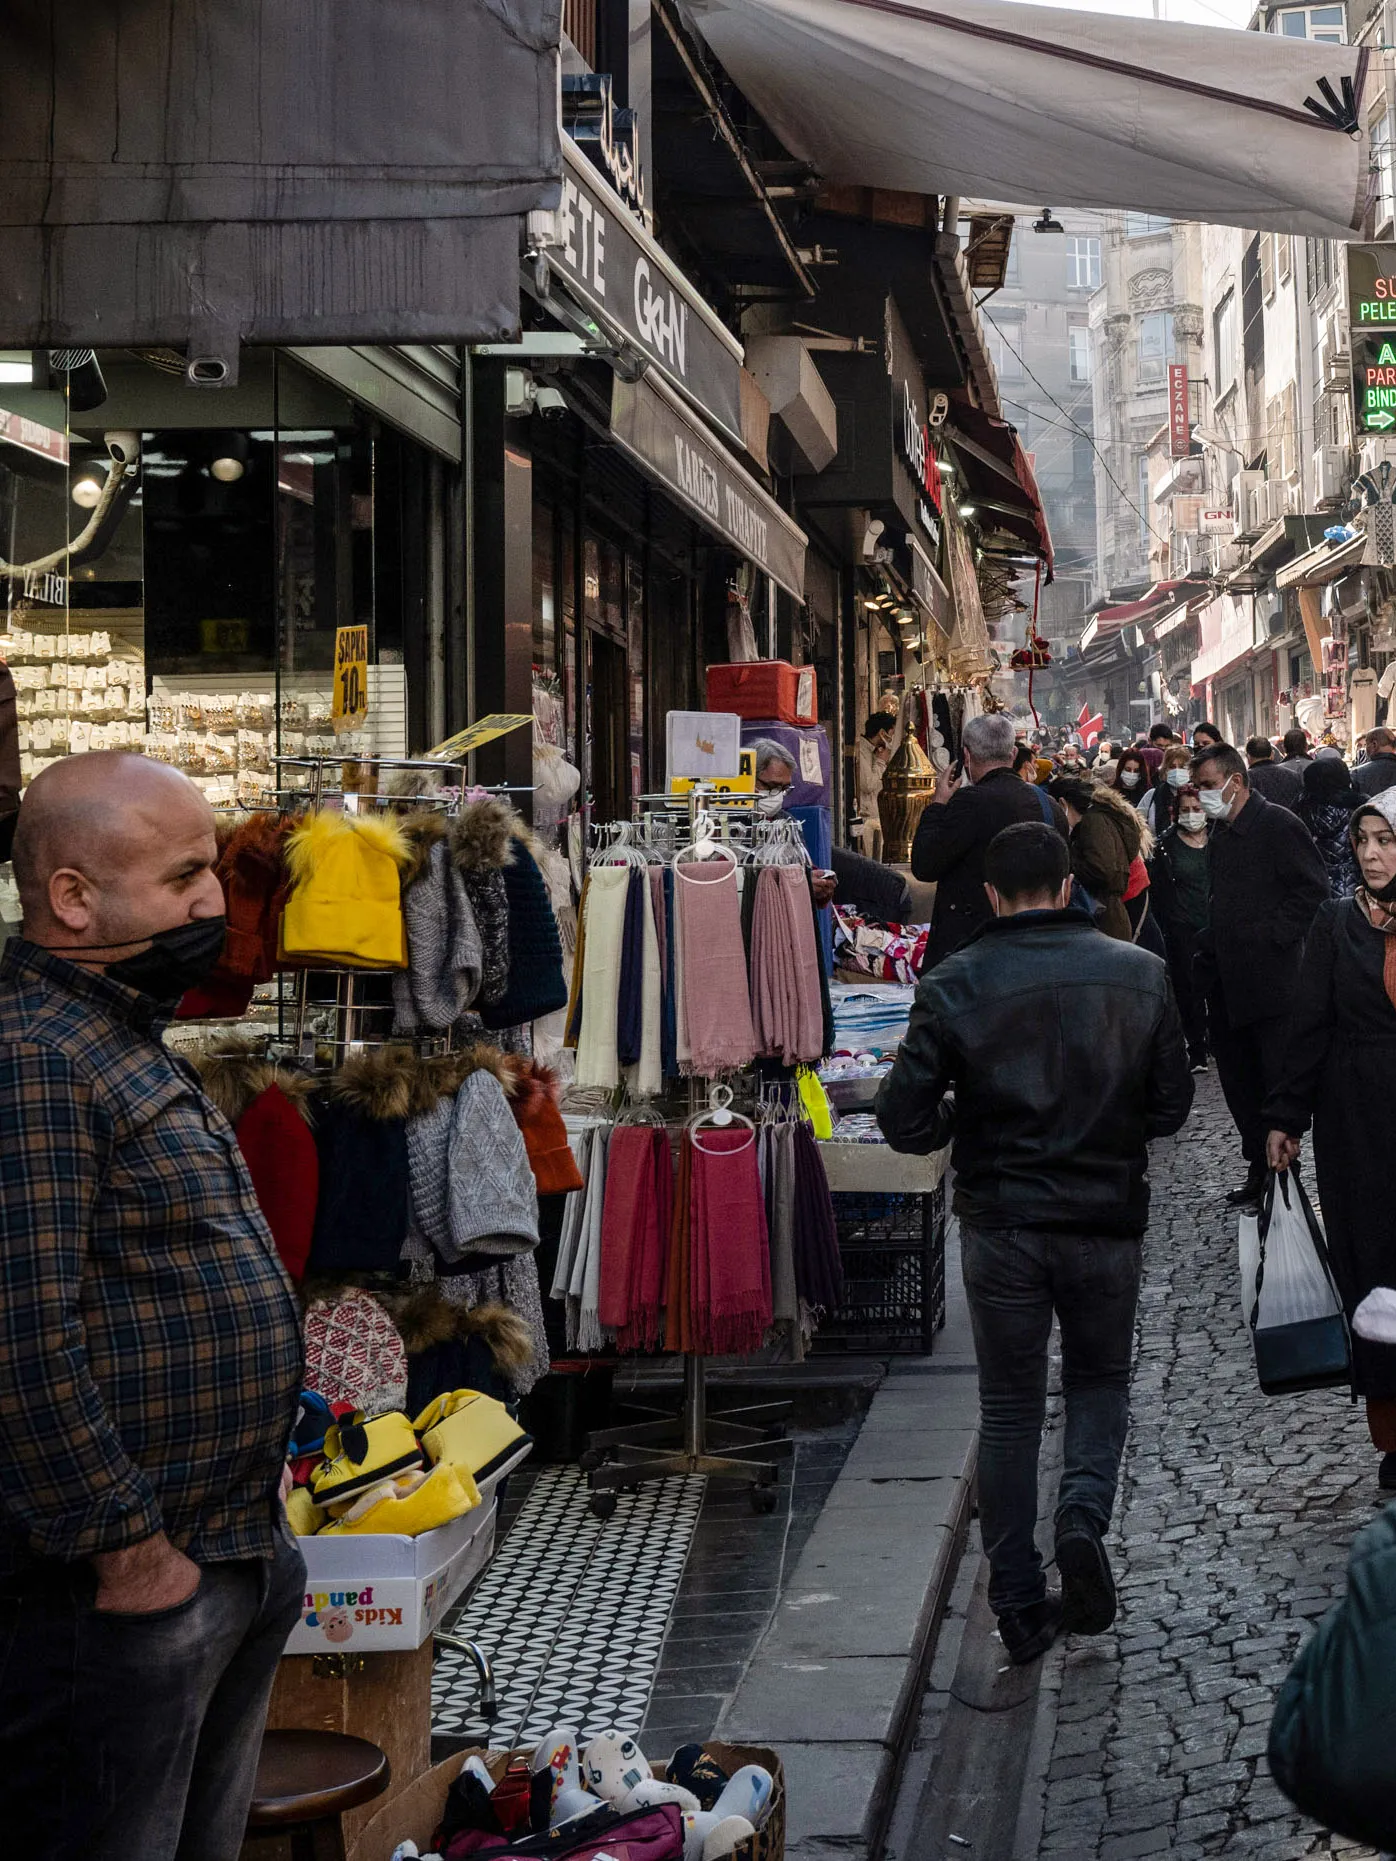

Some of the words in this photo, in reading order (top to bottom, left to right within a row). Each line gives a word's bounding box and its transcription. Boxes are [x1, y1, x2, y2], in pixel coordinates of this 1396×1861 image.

[1174, 368, 1185, 435] ECZANE
[1204, 511, 1234, 520] GN
[338, 630, 366, 670] ŞAPKA
[355, 1607, 403, 1625] Kids
